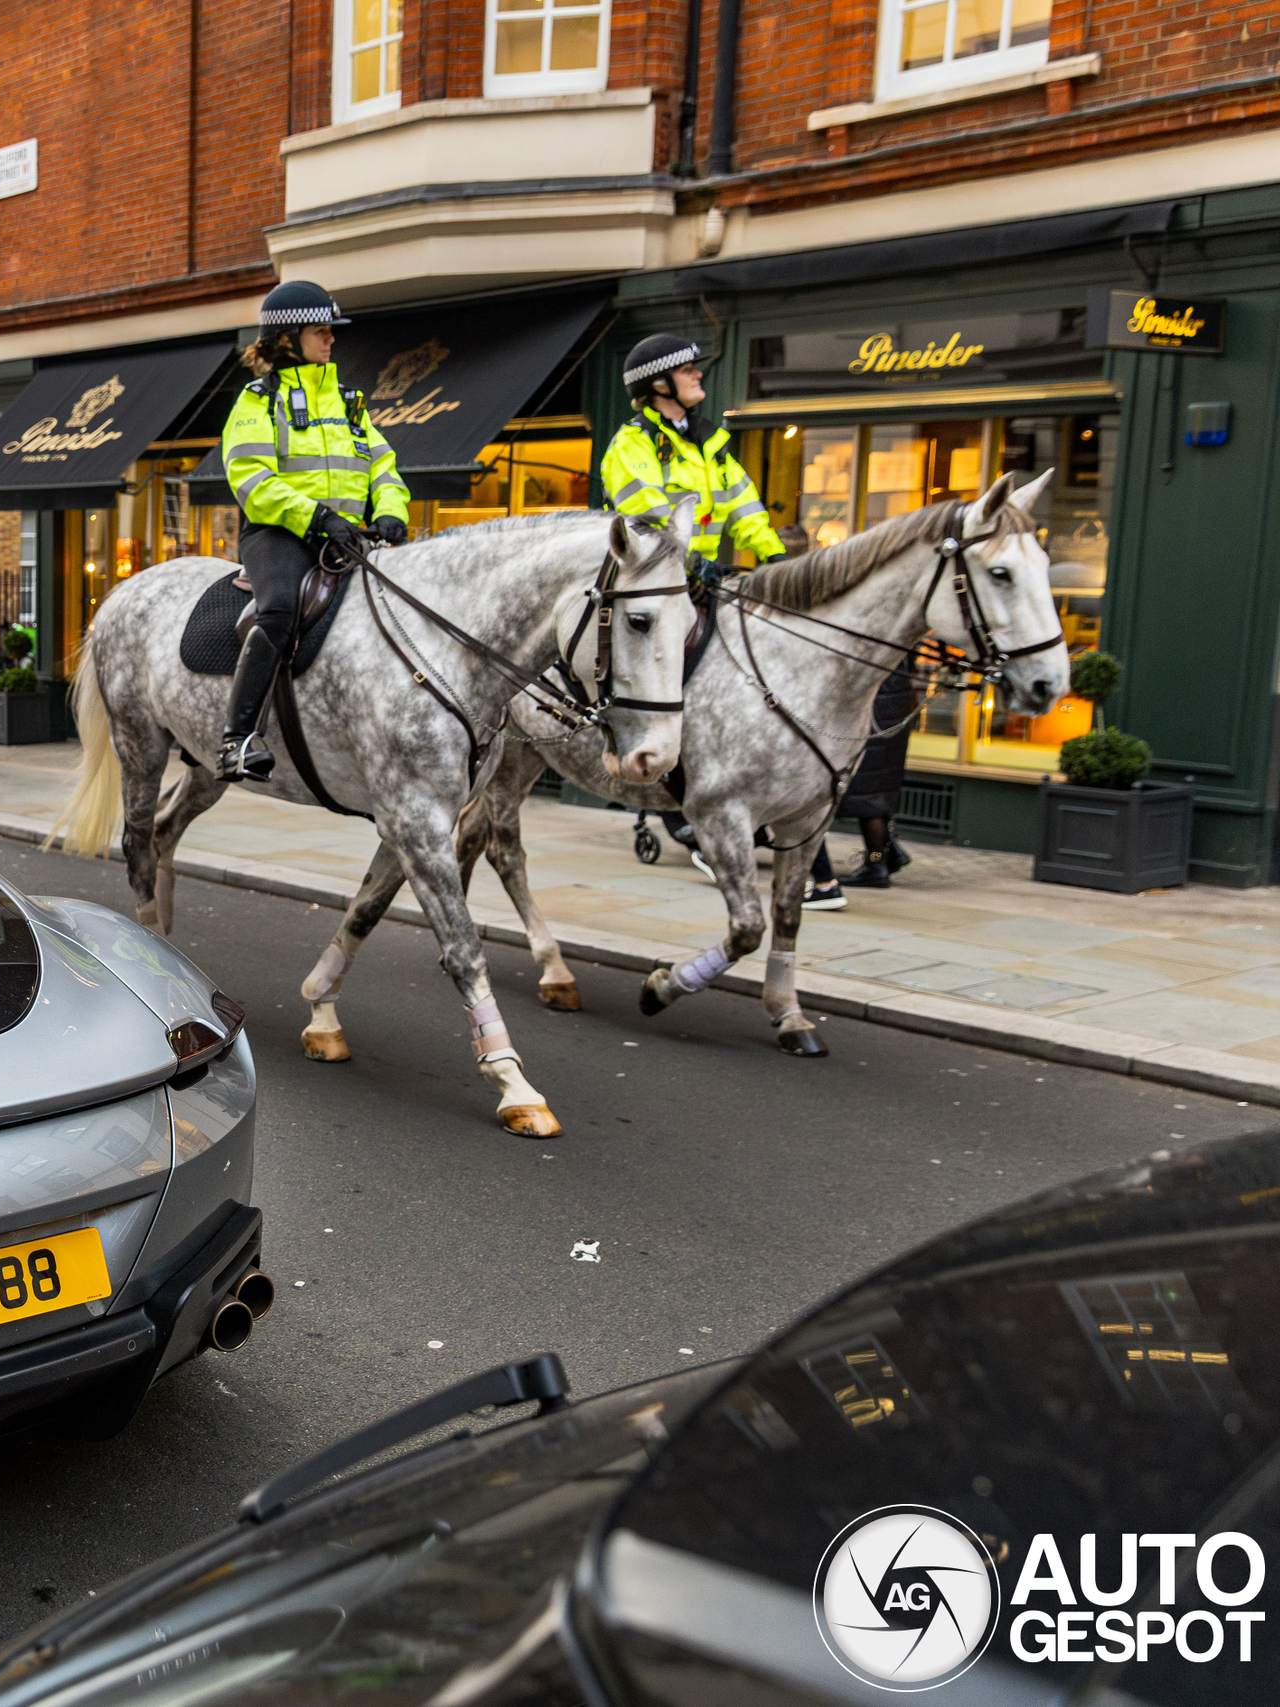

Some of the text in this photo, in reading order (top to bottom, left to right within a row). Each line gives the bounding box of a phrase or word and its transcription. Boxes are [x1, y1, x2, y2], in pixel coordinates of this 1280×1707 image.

[848, 332, 984, 375] Pineider
[235, 418, 257, 428] POLICE
[367, 386, 461, 427] eider
